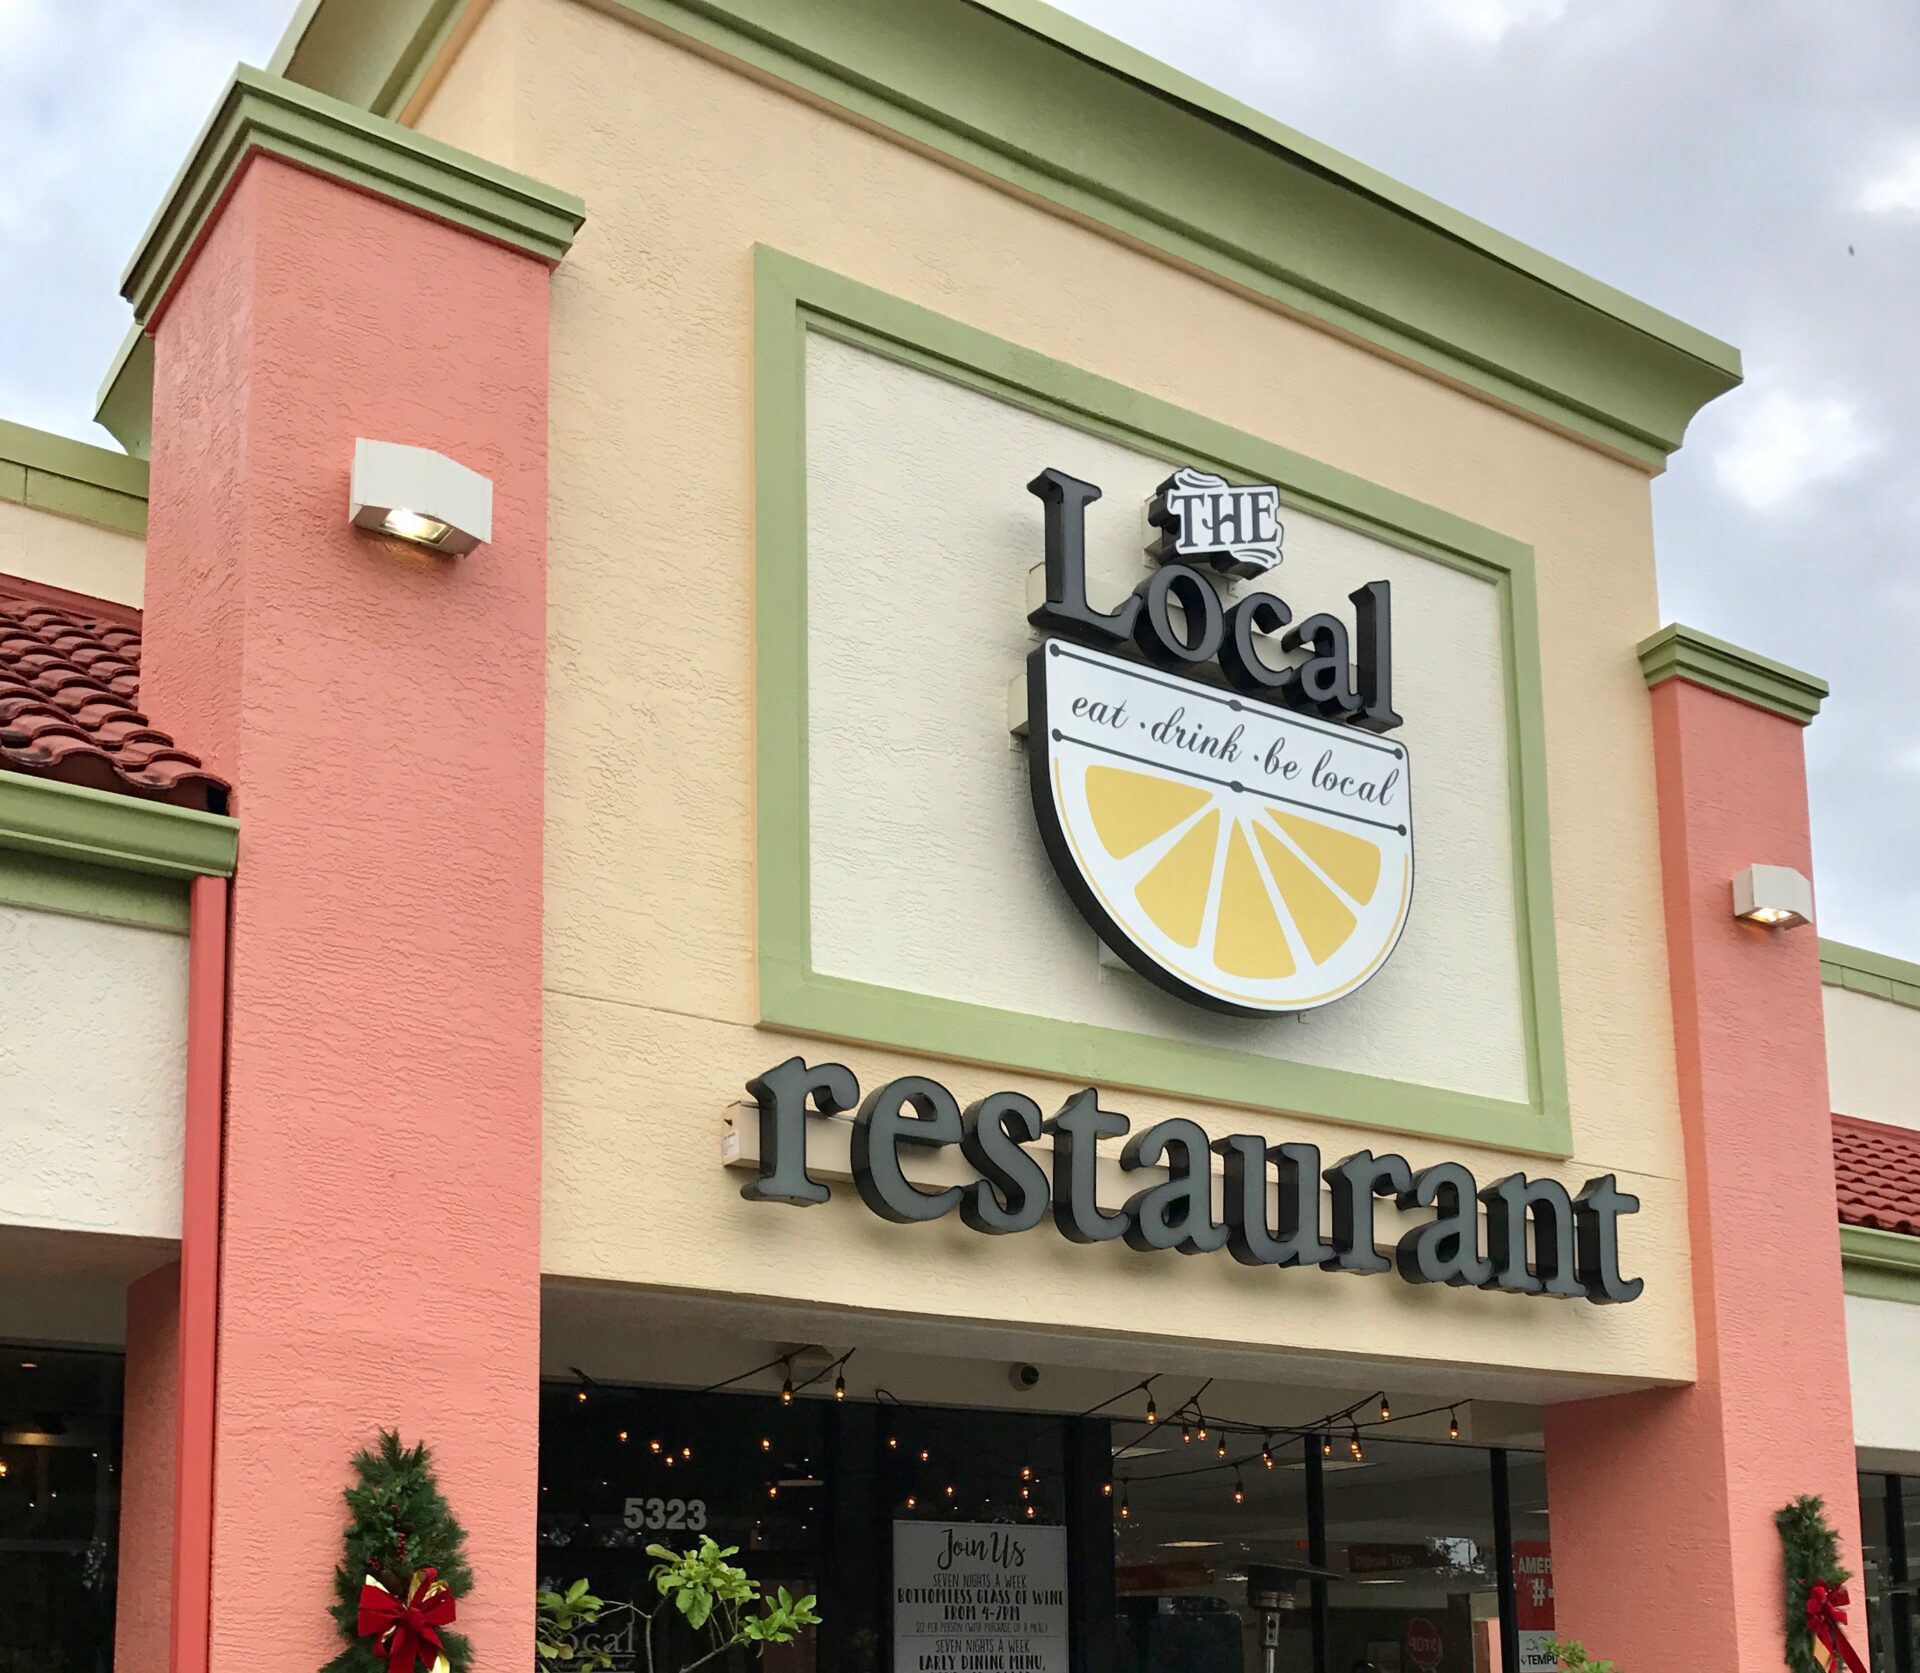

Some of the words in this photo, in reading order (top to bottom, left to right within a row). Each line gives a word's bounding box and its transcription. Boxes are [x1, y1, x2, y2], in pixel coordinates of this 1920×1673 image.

[1170, 491, 1279, 548] THE
[1028, 467, 1403, 732] Local
[1071, 696, 1129, 730] eat
[1311, 749, 1399, 807] local
[740, 1055, 1643, 1304] restaurant
[624, 1496, 707, 1531] 5323
[937, 1529, 988, 1570] Join
[990, 1531, 1026, 1568] Us
[933, 1573, 959, 1588] SEVEN
[963, 1573, 991, 1588] NIGHTS
[1005, 1574, 1027, 1589] WEEK
[898, 1588, 972, 1604] BOTTOMLESS
[977, 1589, 1011, 1604] GLASS
[1015, 1590, 1028, 1604] OF
[1032, 1590, 1064, 1606] WINE
[944, 1605, 976, 1620] FROM
[981, 1606, 1020, 1620] 4-7PM
[940, 1622, 963, 1633] PERSON
[936, 1639, 962, 1653] SEVEN
[966, 1639, 993, 1654] NIGHTS
[1008, 1640, 1031, 1654] WEEK
[919, 1655, 955, 1671] EARLY
[961, 1655, 1005, 1671] DINING
